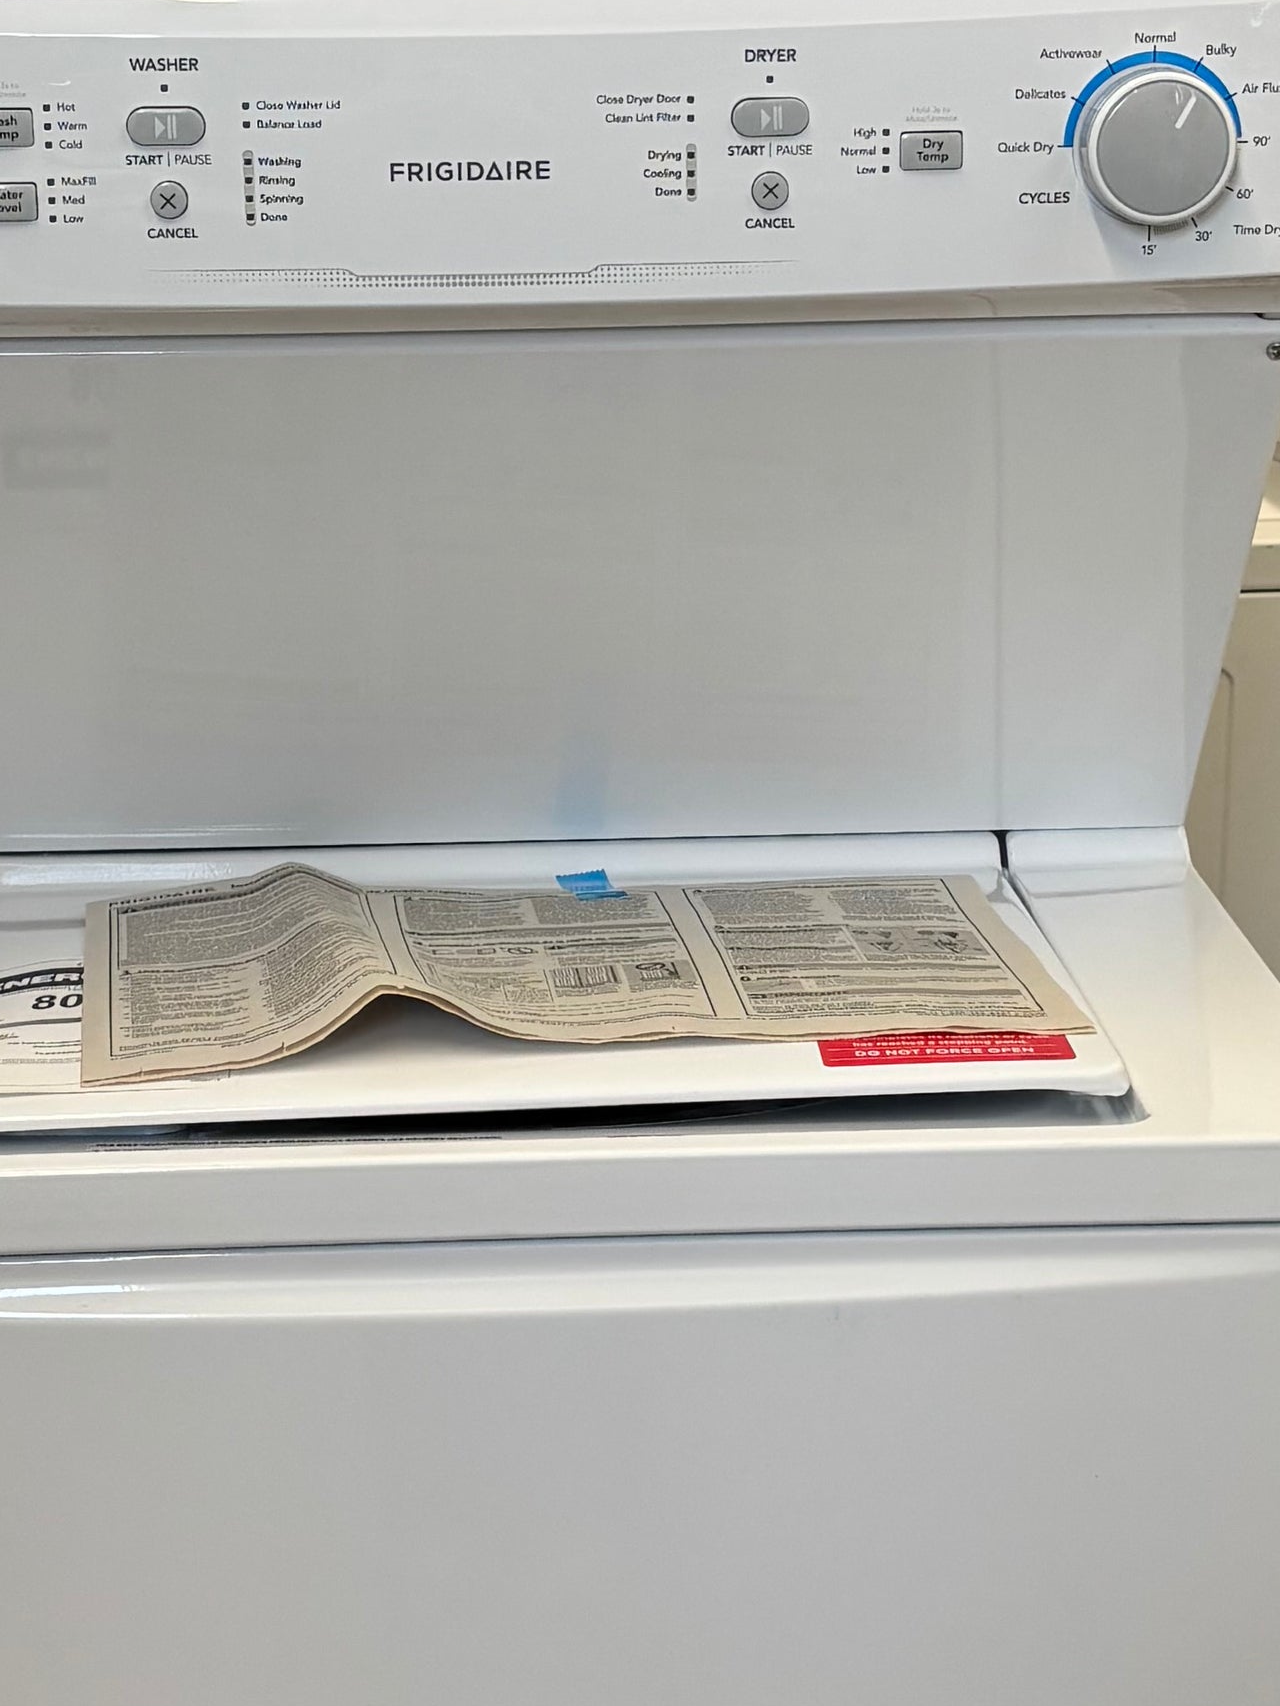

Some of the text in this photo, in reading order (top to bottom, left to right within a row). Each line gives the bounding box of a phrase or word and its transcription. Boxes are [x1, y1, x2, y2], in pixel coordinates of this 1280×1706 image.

[1135, 32, 1176, 44] Normal
[744, 49, 797, 62] DRYER
[1040, 48, 1102, 59] Activewear
[1206, 44, 1237, 57] Bulky
[129, 58, 199, 71] WASHER
[1015, 89, 1066, 99] Delicates
[1242, 83, 1260, 94] Air
[256, 100, 283, 110] Close
[326, 100, 341, 110] Lid
[596, 94, 681, 106] Close Dryer Door
[57, 103, 76, 112] Hot
[605, 113, 681, 123] Clean Lint Filter
[58, 122, 87, 131] Warm
[854, 127, 876, 139] High
[59, 140, 83, 150] Cold
[727, 144, 812, 156] START PAUSE
[840, 145, 876, 156] Normal
[923, 138, 944, 152] Dry
[997, 142, 1054, 155] Quick Dry
[125, 154, 212, 165] START PAUSE
[648, 150, 682, 162] Drying
[917, 151, 949, 163] Temp
[258, 157, 302, 168] Washing
[389, 160, 551, 182] FRIGIDAIRE
[643, 169, 682, 180] Cooling
[857, 165, 876, 174] Low
[259, 175, 296, 187] Rinsing
[655, 187, 682, 196] Done
[62, 195, 85, 205] Med
[260, 194, 304, 205] Spinning
[1019, 192, 1070, 205] CYCLES
[64, 214, 84, 223] Low
[261, 212, 288, 222] Done
[745, 218, 795, 229] CANCEL
[147, 228, 199, 239] CANCEL
[1233, 225, 1261, 236] Time
